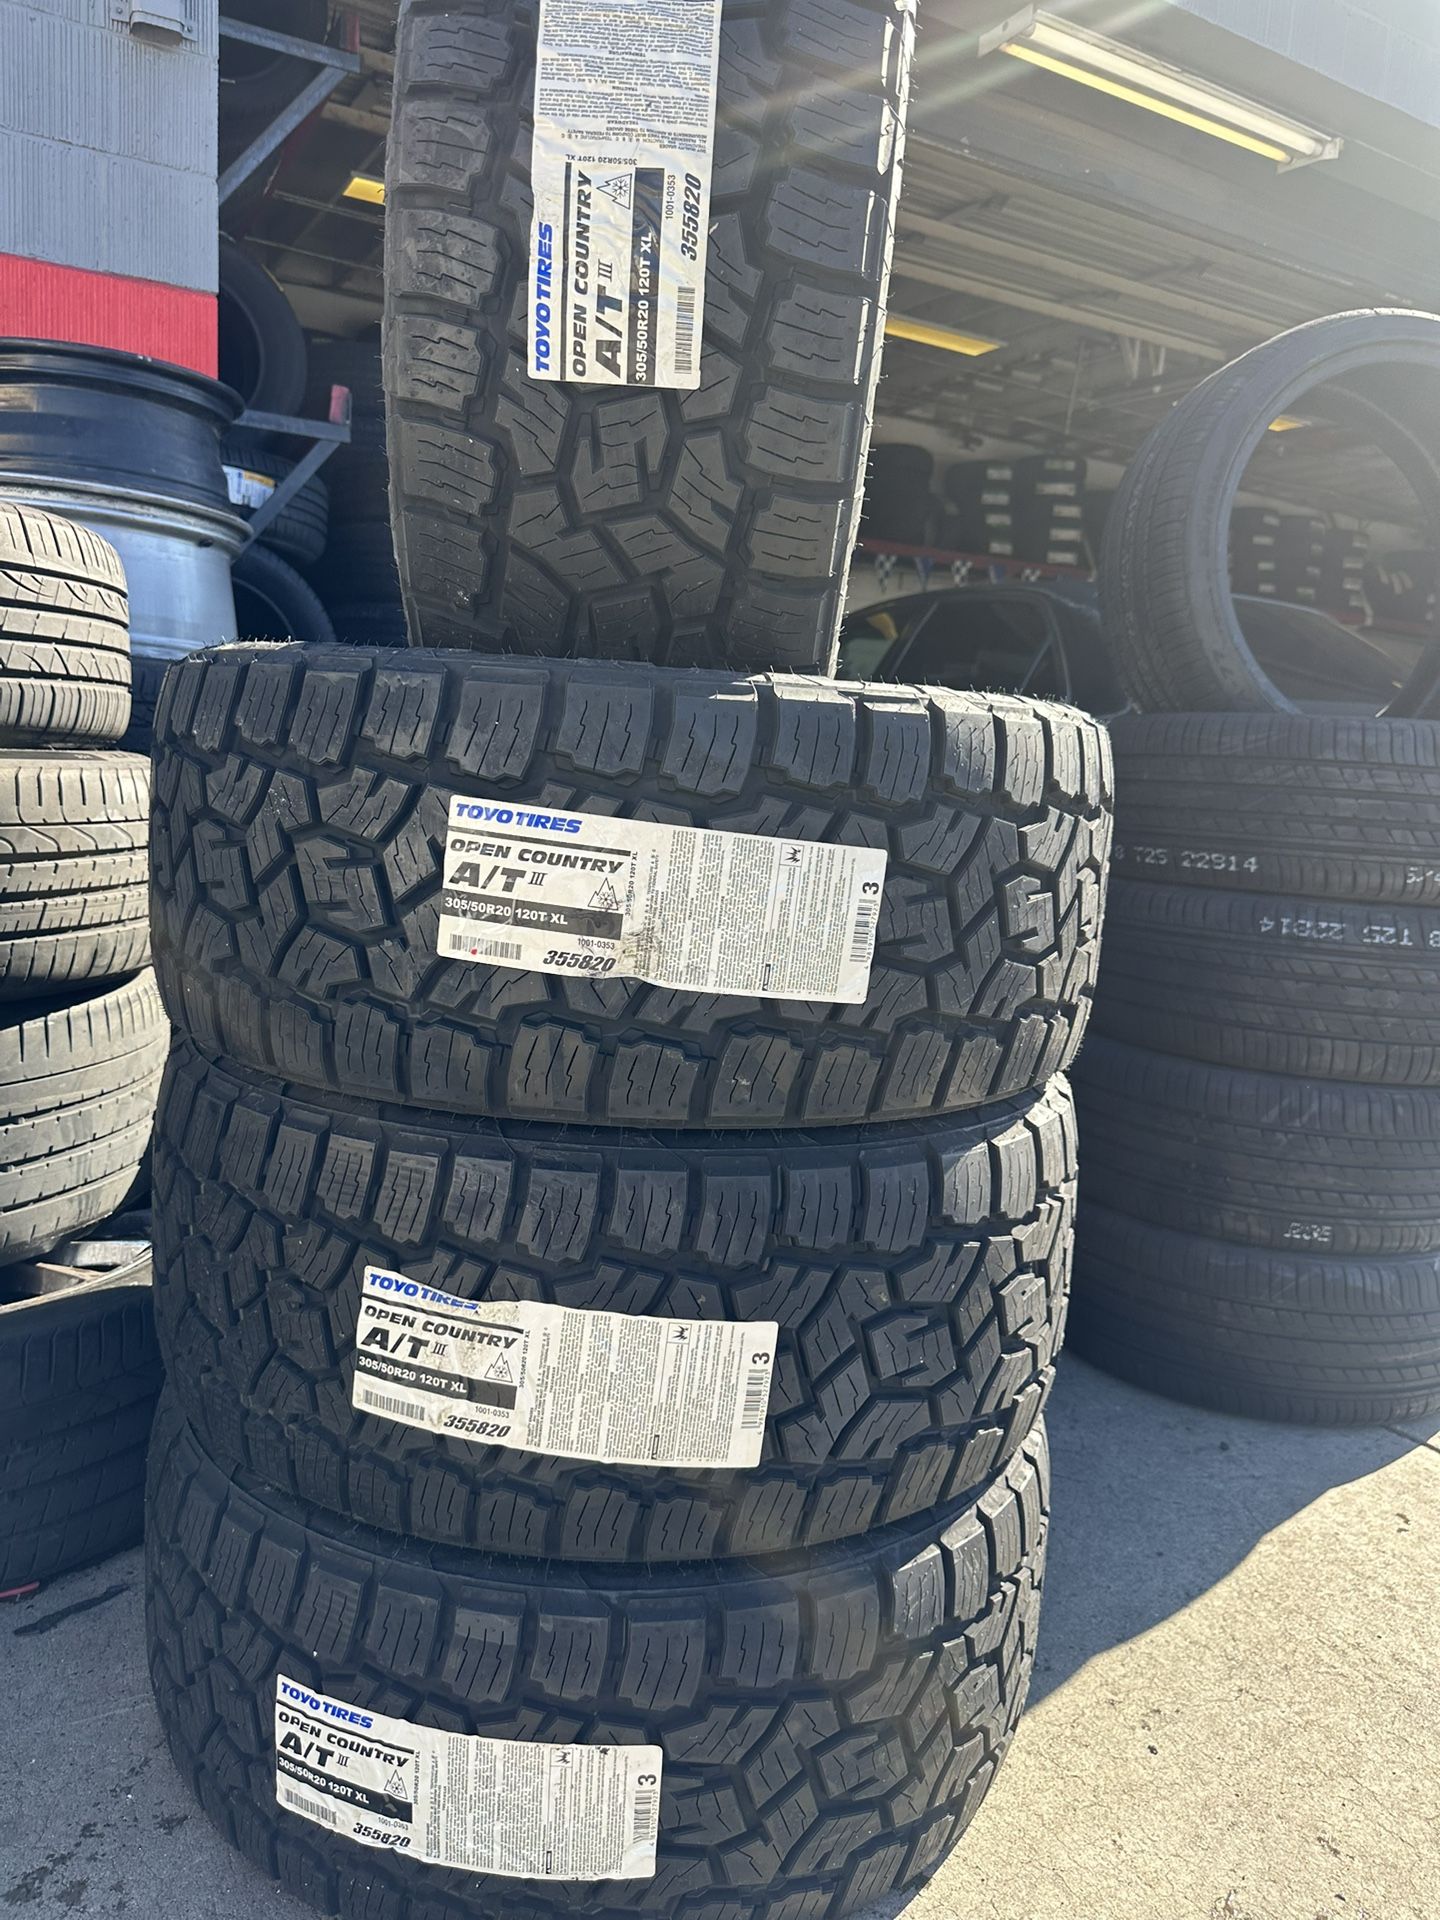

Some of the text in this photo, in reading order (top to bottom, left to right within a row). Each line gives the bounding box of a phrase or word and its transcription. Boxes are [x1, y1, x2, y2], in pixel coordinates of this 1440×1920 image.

[565, 153, 576, 161] XL
[577, 155, 596, 163] 120T
[665, 174, 677, 220] 1001-0353
[680, 172, 702, 261] 355820
[572, 169, 592, 377] OPEN COUNTRY
[635, 232, 653, 382] 305/50R20 120T XL
[595, 283, 623, 379] A/T
[449, 838, 625, 874] OPEN COUNTRY
[632, 851, 638, 861] XL
[448, 861, 527, 893] A/T
[862, 881, 880, 895] 3
[444, 896, 569, 926] 305/50R20 120T XL
[577, 937, 616, 950] 1001-0353
[542, 949, 617, 973] 355820
[361, 1326, 431, 1359] A/T
[364, 1304, 519, 1350] OPEN COUNTRY
[752, 1352, 770, 1365] 3
[358, 1356, 468, 1394] 305/50R20 120T XL
[443, 1414, 512, 1438] 355820
[475, 1405, 510, 1419] 1001-0353
[278, 1711, 410, 1768] OPEN COUNTRY
[280, 1731, 335, 1767] A/T
[278, 1757, 370, 1804] 305/50R20 120T XL
[637, 1774, 657, 1786] 3
[352, 1822, 412, 1848] 355820
